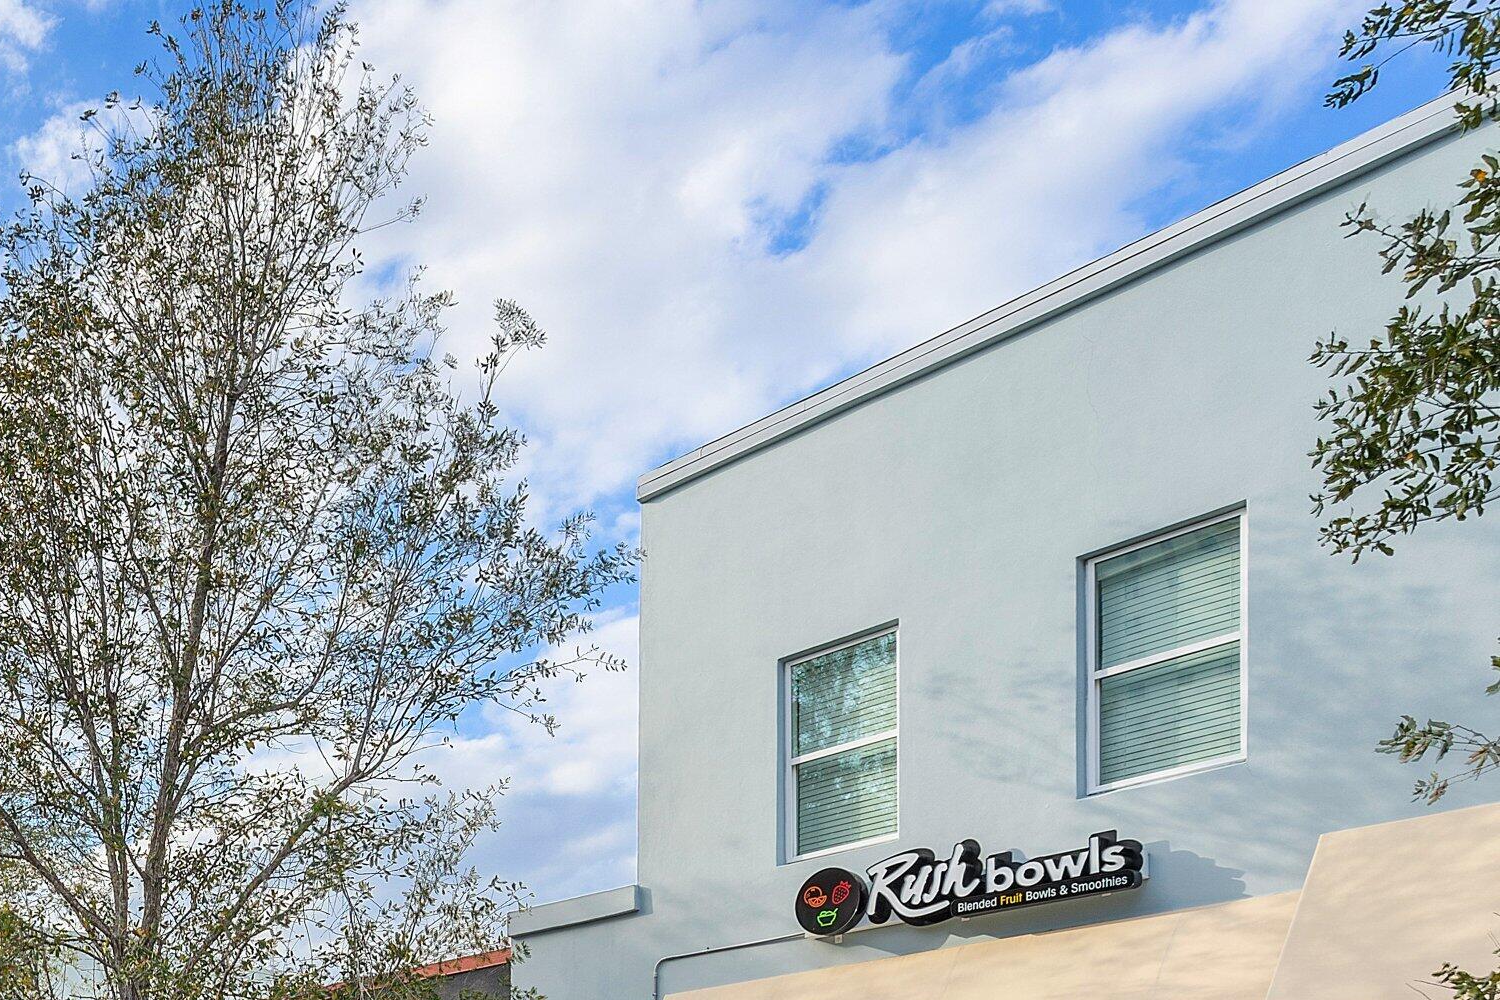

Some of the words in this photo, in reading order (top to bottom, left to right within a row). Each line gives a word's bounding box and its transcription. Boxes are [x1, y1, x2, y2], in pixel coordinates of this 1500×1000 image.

[867, 843, 981, 918] Rush
[986, 836, 1127, 894] bowls
[957, 897, 997, 913] Blended
[1000, 892, 1023, 906] Fruit
[1025, 887, 1057, 902] Bowls
[1059, 885, 1069, 895] &
[1070, 874, 1128, 894] Smoothies
